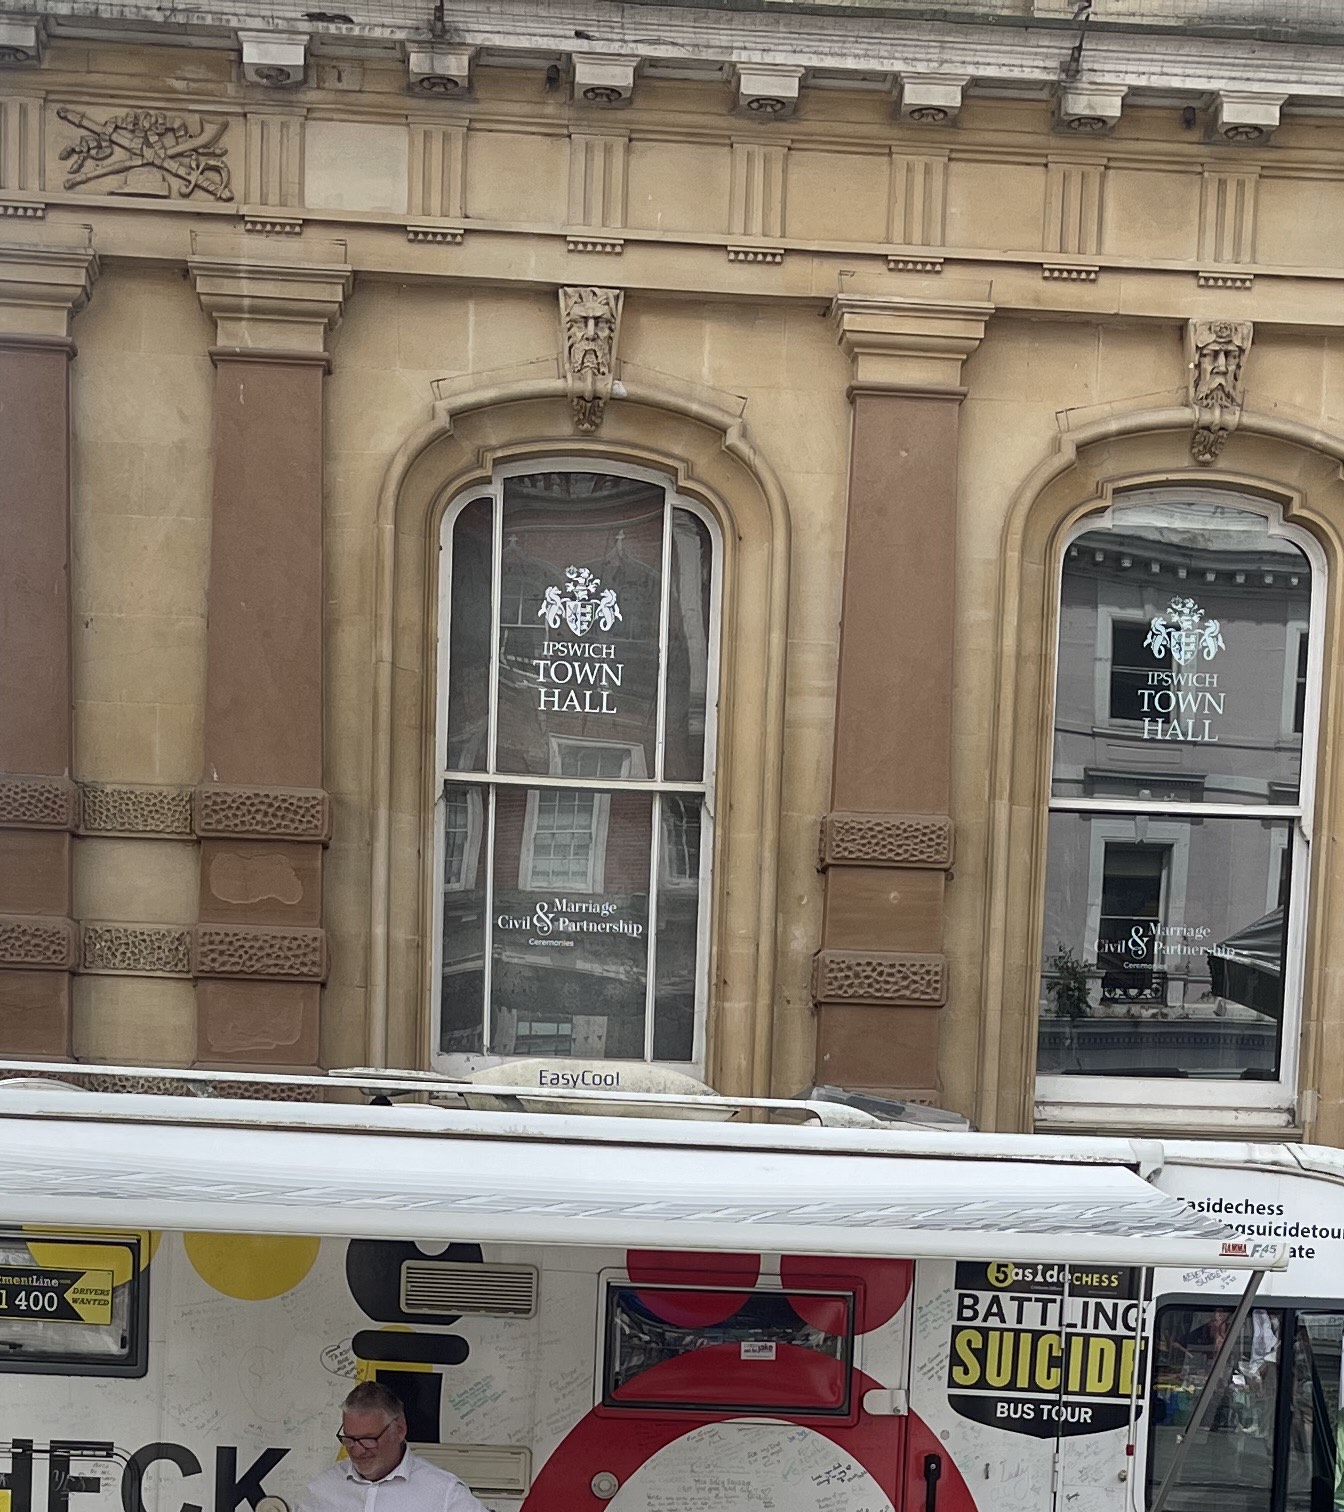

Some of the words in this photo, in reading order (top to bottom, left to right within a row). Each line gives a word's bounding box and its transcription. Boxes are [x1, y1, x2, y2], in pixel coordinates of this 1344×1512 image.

[543, 641, 616, 659] IPSWICH
[533, 660, 624, 687] TOWN
[1147, 671, 1219, 688] IPSWICH
[538, 688, 617, 714] HALL
[1137, 689, 1227, 715] TOWN
[1142, 717, 1219, 741] HALL
[553, 898, 618, 917] Marriage
[497, 915, 531, 930] Civil
[532, 902, 555, 936] &
[558, 917, 643, 937] Partnership
[1148, 922, 1211, 940] Marriage
[528, 937, 575, 947] Ceremonies
[1094, 939, 1126, 953] Civil
[1127, 925, 1150, 960] &
[1153, 942, 1236, 958] Partnership
[539, 1069, 620, 1088] EasyCool
[15, 1291, 58, 1312] 400
[71, 1297, 110, 1306] WANTED
[72, 1287, 111, 1296] DRIVERS
[956, 1292, 1146, 1333] BATTLING
[952, 1328, 1145, 1395] SUICIDE
[996, 1402, 1035, 1419] BUS
[1040, 1404, 1093, 1422] TOUR
